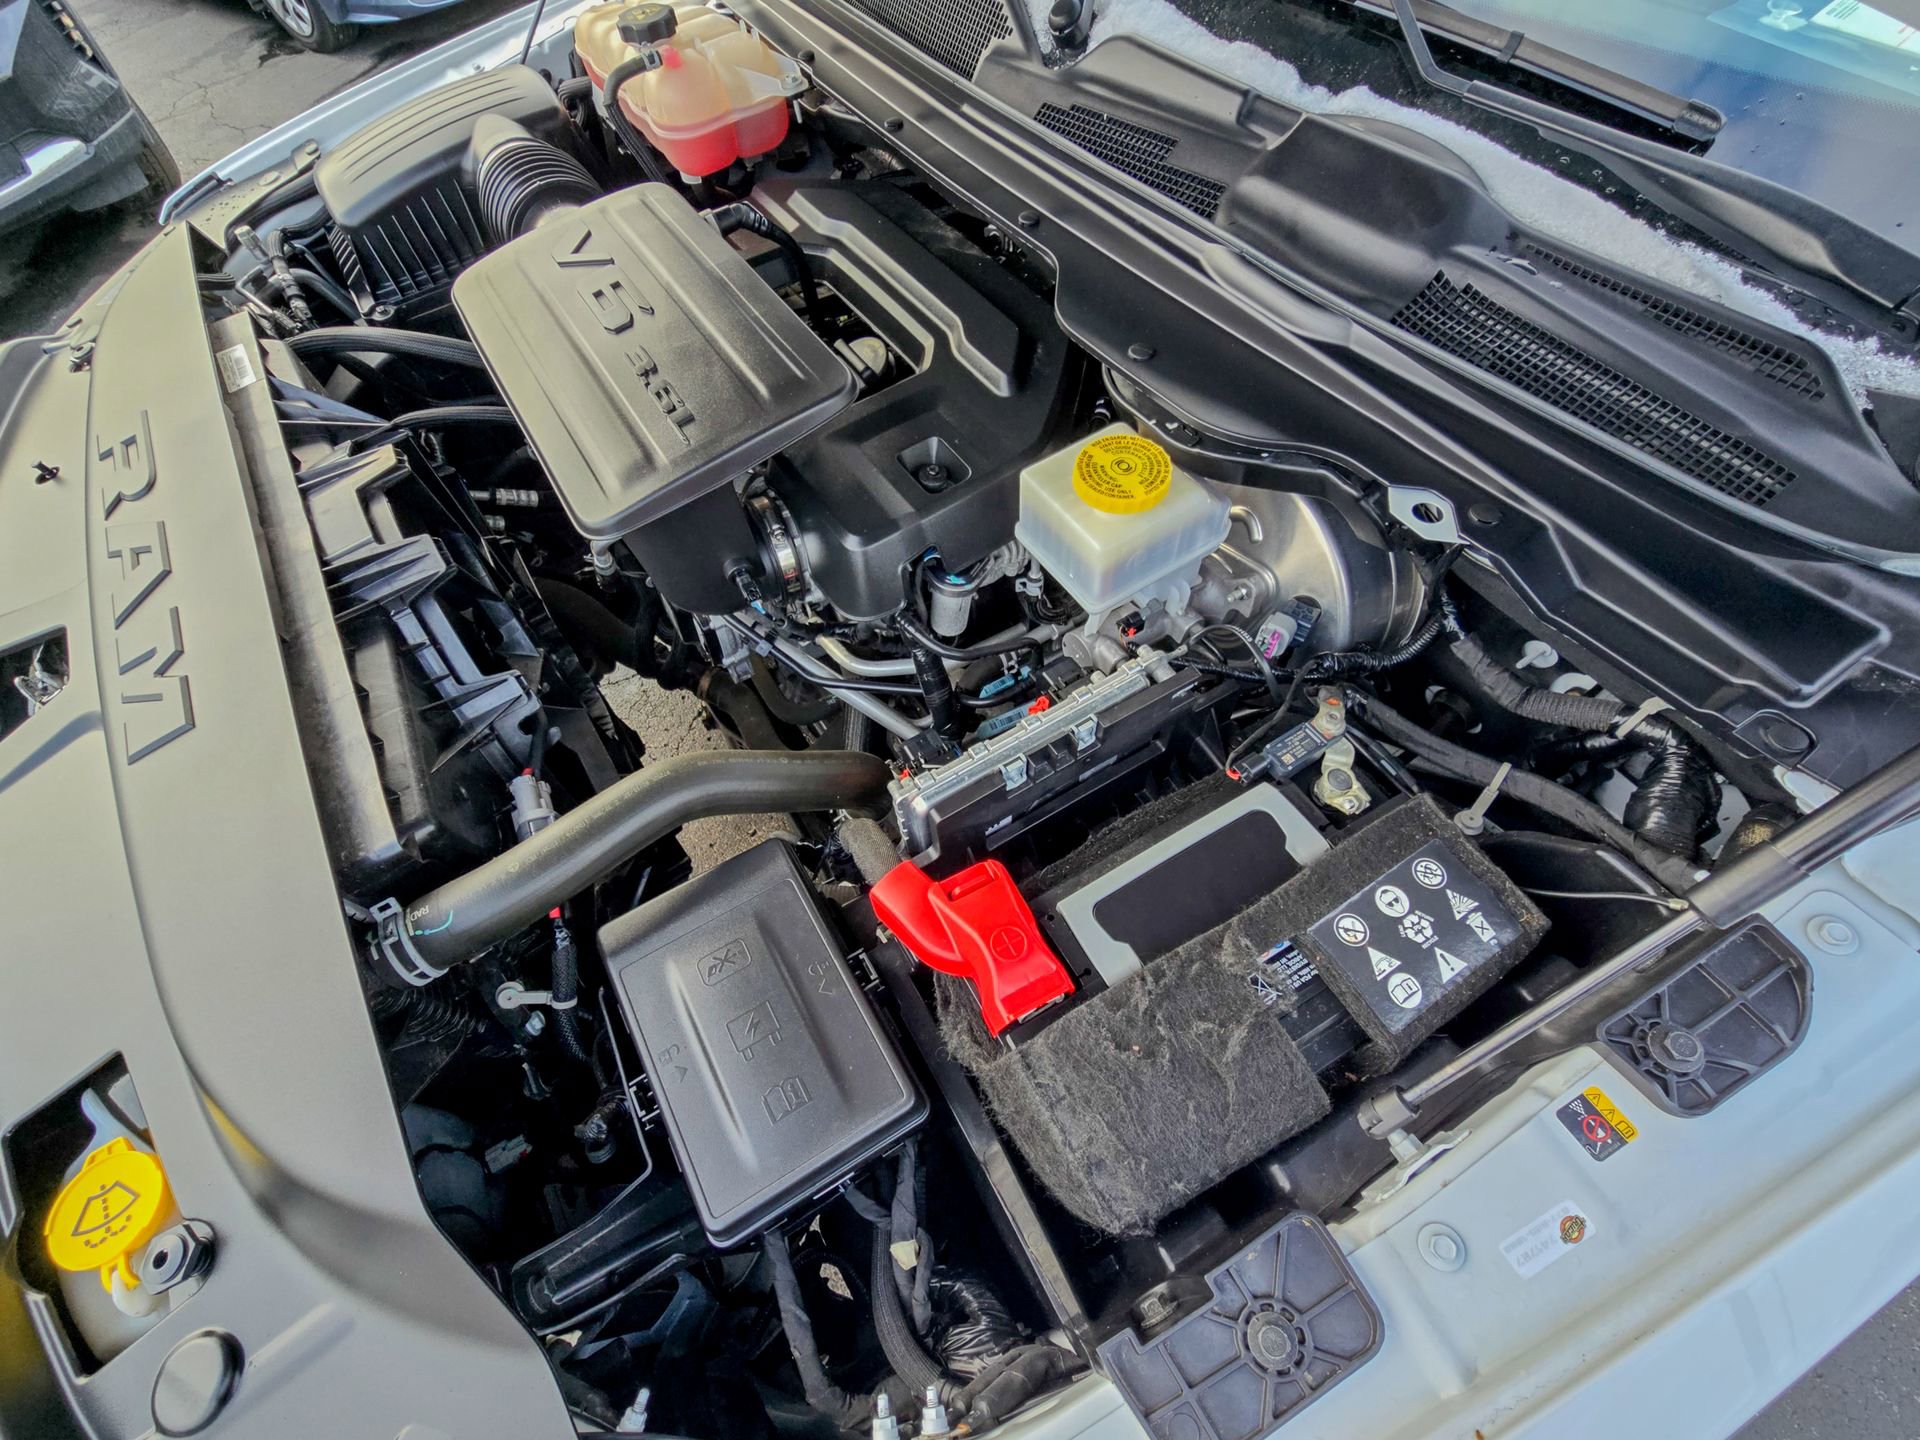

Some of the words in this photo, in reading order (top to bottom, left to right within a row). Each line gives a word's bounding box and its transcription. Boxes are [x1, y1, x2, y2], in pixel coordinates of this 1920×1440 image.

[551, 229, 655, 335] V6
[624, 344, 696, 445] 3.6L
[97, 410, 196, 766] RAM
[410, 904, 429, 922] RAD
